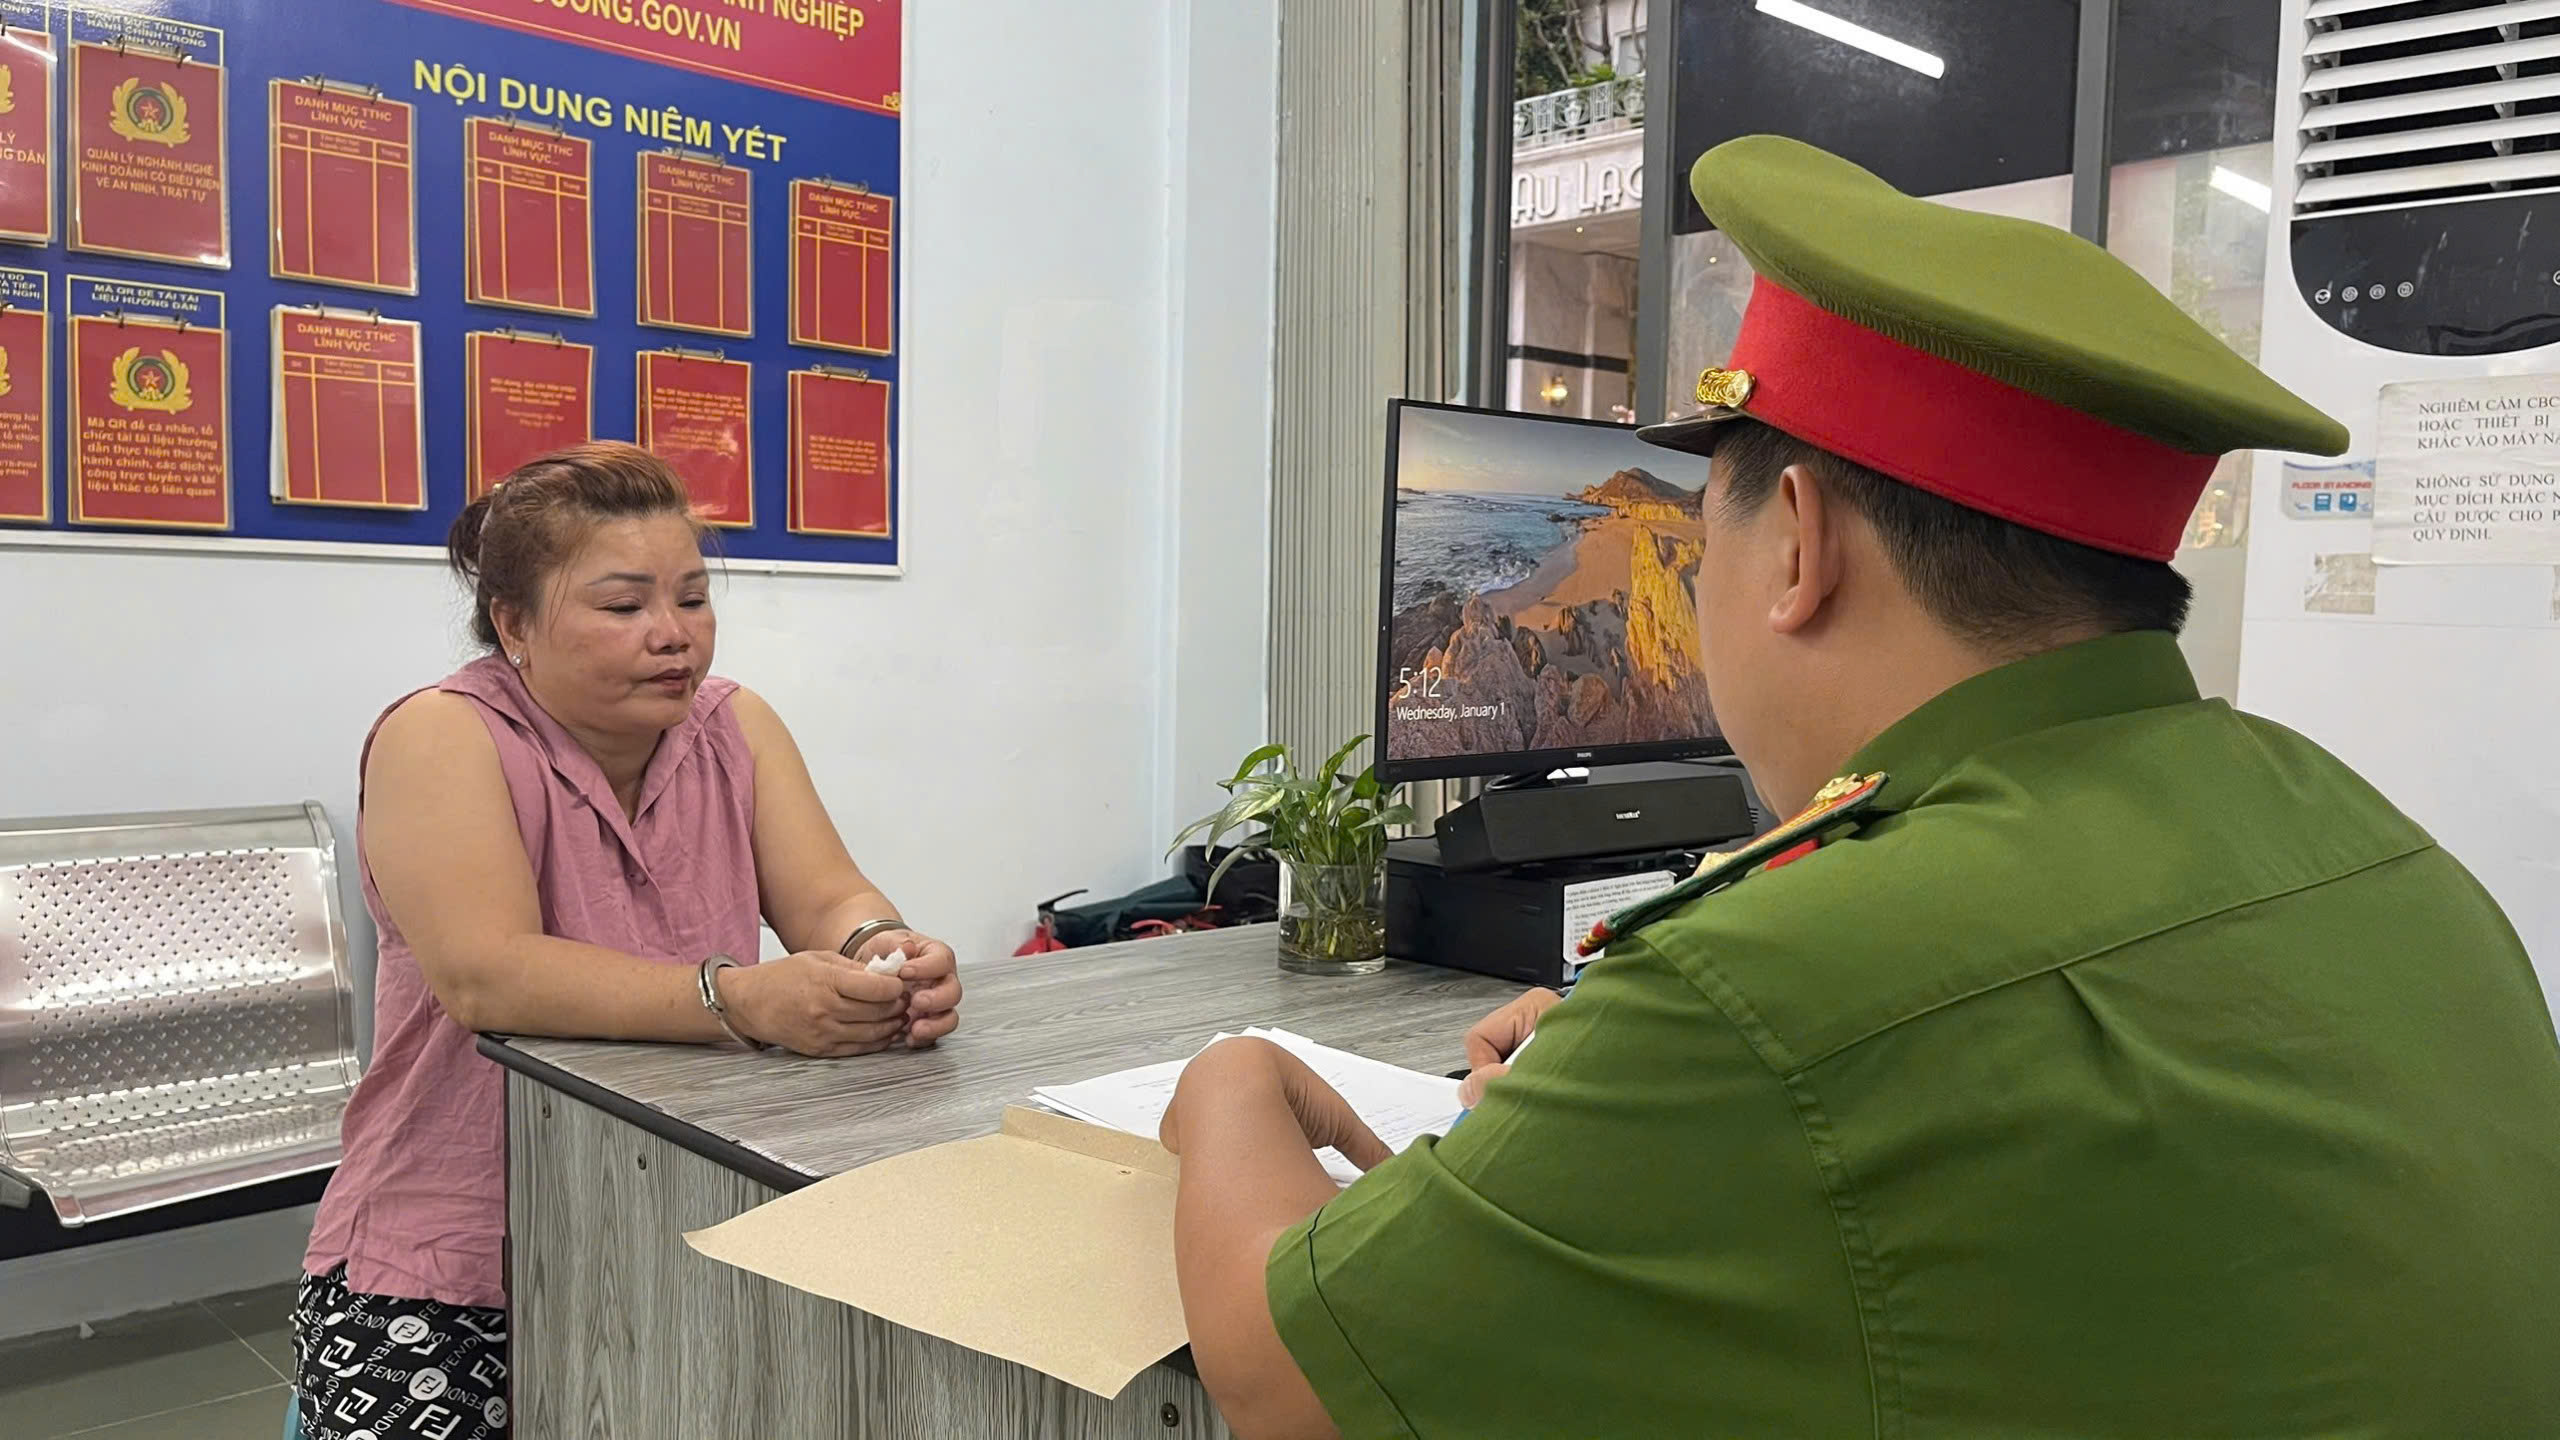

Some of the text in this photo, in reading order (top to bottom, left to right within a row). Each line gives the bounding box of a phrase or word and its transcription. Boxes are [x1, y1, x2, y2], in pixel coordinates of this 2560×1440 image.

[530, 0, 740, 51] NG.GOV.VN
[295, 95, 392, 122] DANH MỤC TTHC
[414, 60, 787, 163] NỘI DUNG NIÊM YẾT
[0, 147, 14, 160] G
[488, 132, 519, 145] DANH
[547, 143, 573, 157] TTHC
[120, 151, 134, 165] LÝ
[81, 160, 107, 173] KINH
[150, 168, 166, 182] CÓ
[195, 177, 220, 191] KIỆN
[112, 178, 128, 190] AN
[161, 184, 188, 200] TRẬT
[191, 189, 207, 203] TỰ
[297, 323, 333, 336] DANH
[365, 330, 397, 343] TTHC
[2419, 399, 2480, 414] NGHIÊM
[2485, 396, 2521, 411] CẤM
[108, 418, 127, 430] QR
[2418, 414, 2550, 433] HOẶC THIẾT BỊ
[153, 433, 175, 447] liệu
[2465, 432, 2498, 448] VÀO
[2502, 431, 2539, 447] MÁY
[87, 468, 117, 481] công
[2415, 474, 2470, 489] KHÔNG
[2509, 473, 2555, 488] DỤNG
[186, 486, 216, 499] quan
[2292, 481, 2372, 489] FLOOR STANDING
[2415, 494, 2449, 507] MỤC
[2456, 491, 2493, 505] ĐÍCH
[2501, 489, 2546, 504] KHÁC
[2455, 510, 2500, 524] ĐƯỢC
[2508, 509, 2543, 522] CHO
[2413, 528, 2493, 542] QUY ĐỊNH.
[1399, 666, 1442, 699] 5:12
[1396, 702, 1505, 722] Wednesday, January 1
[363, 1363, 412, 1384] FENDI
[370, 1395, 415, 1436] FENDI
